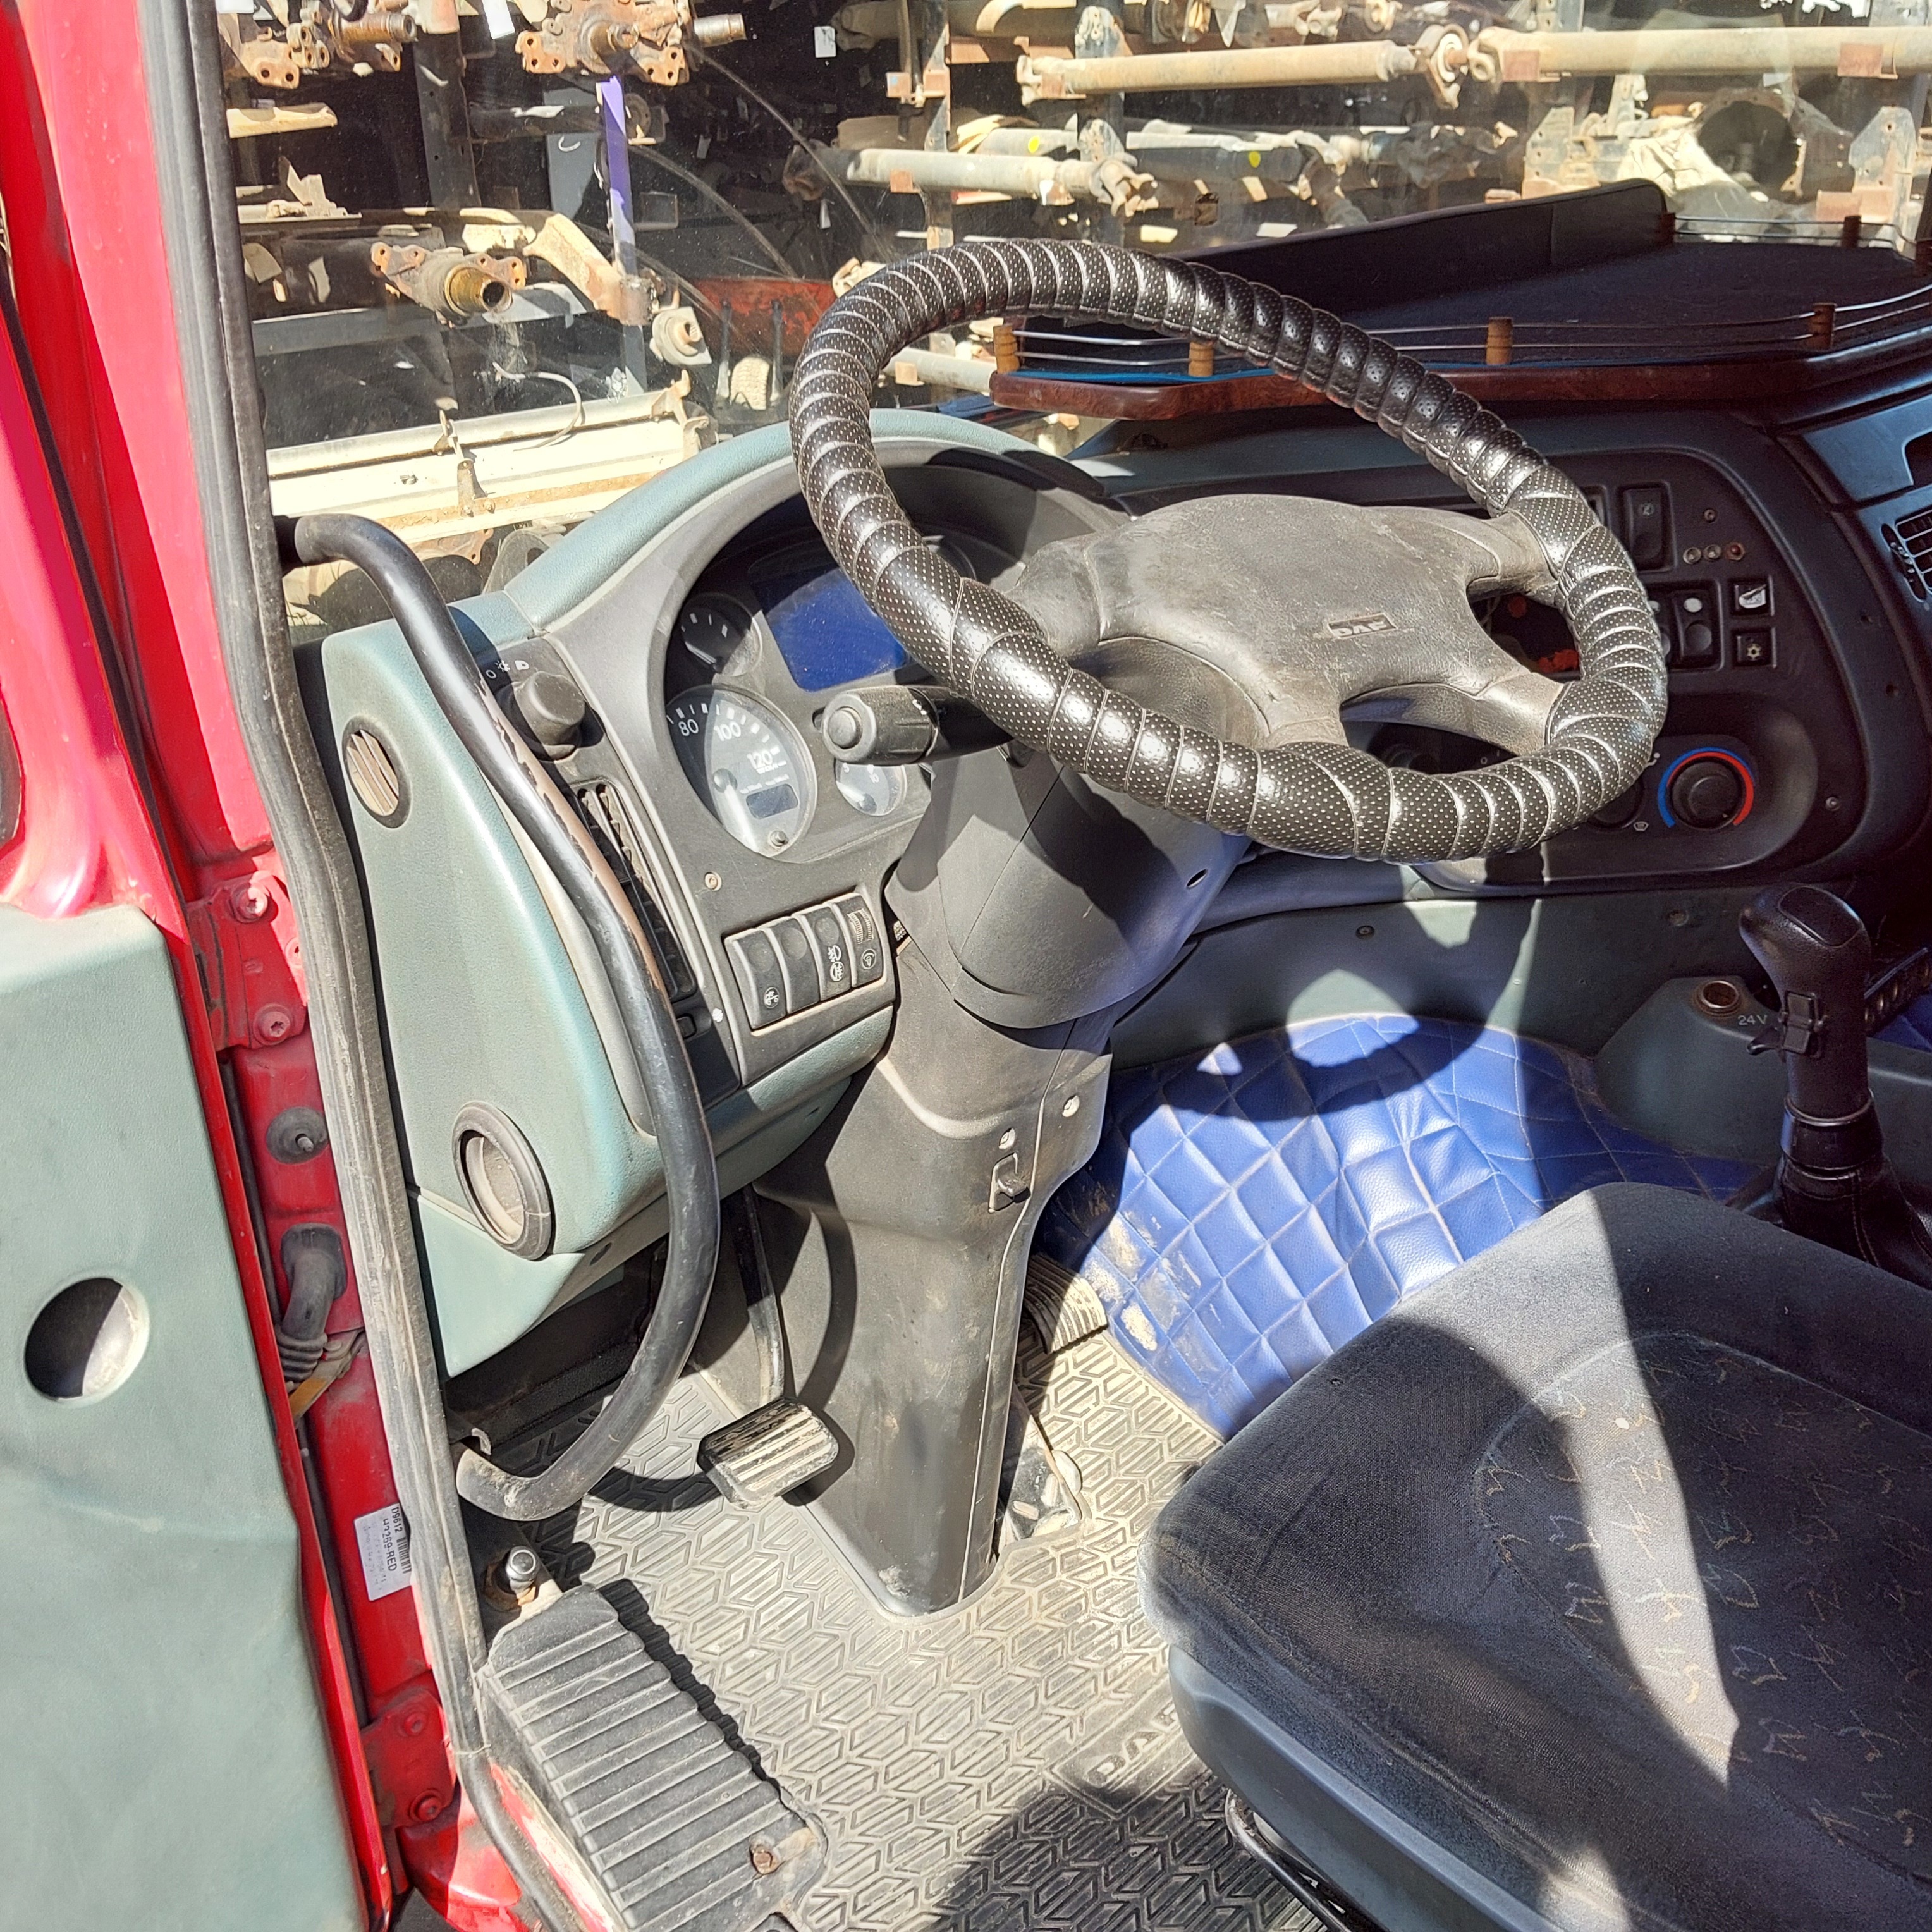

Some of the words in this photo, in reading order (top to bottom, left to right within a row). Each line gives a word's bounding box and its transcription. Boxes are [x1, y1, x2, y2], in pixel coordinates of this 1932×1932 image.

[1333, 621, 1389, 636] DAF
[678, 718, 699, 737] 80
[713, 721, 742, 742] 100
[746, 750, 773, 769] 120
[391, 1507, 403, 1533] D9612
